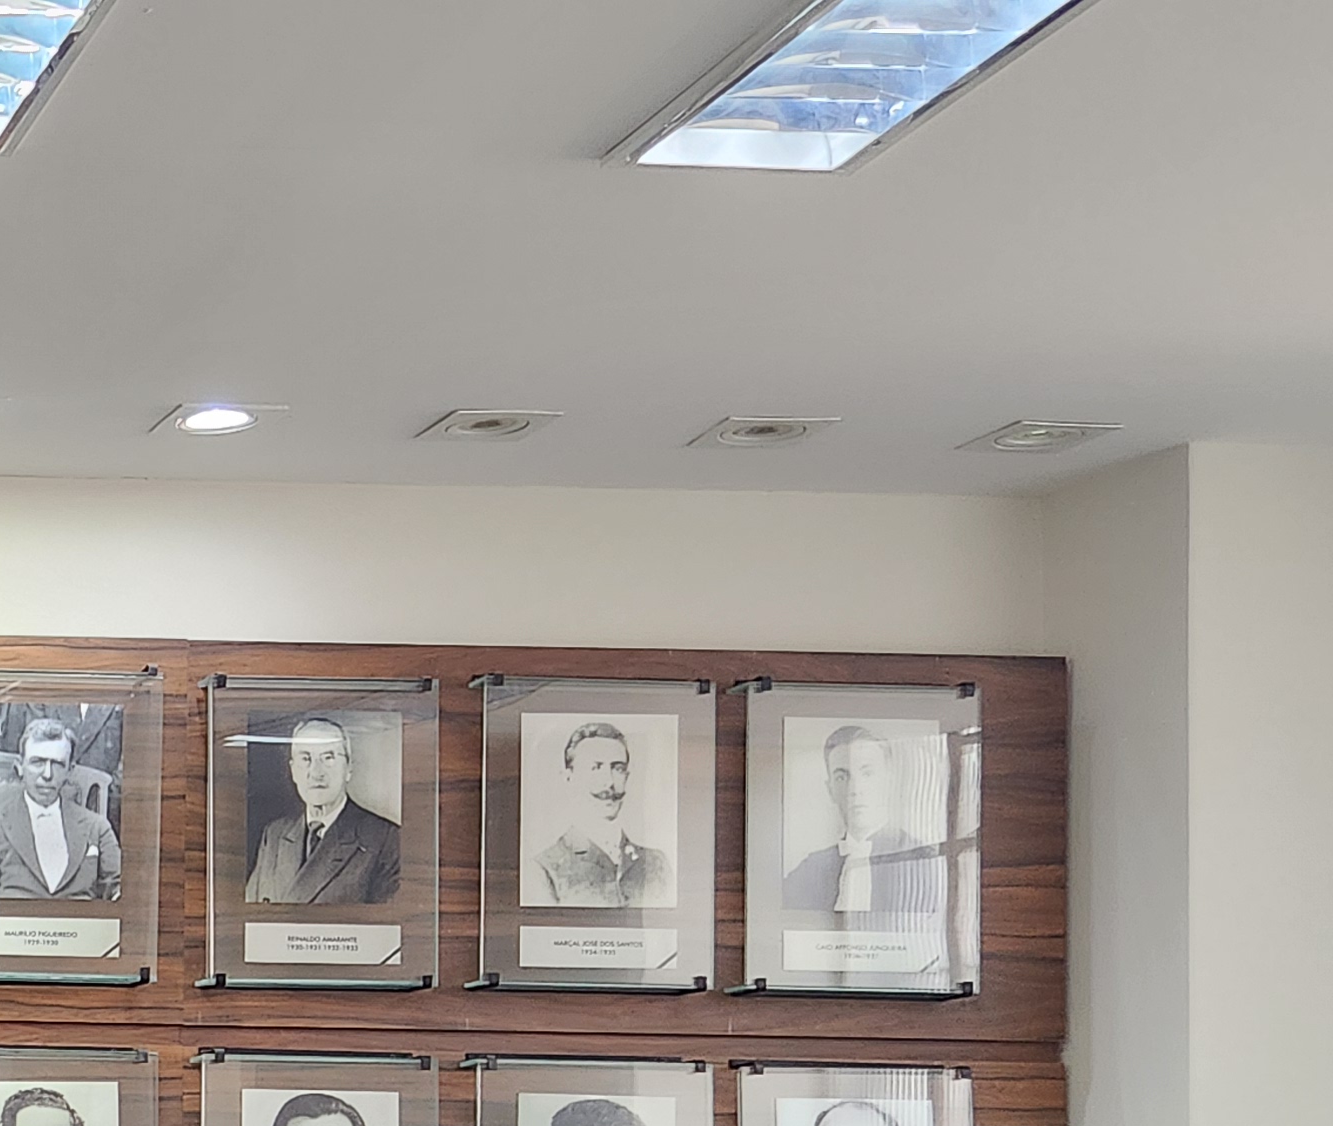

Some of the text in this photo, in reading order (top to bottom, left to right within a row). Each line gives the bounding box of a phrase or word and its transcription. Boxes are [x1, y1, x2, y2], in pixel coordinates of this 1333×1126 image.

[38, 931, 78, 939] FIGUEIREDO
[287, 935, 358, 945] REINALDO AMARANTE
[554, 941, 580, 950] MARÇAL
[600, 941, 615, 949] DOS
[616, 942, 644, 950] SANTOS
